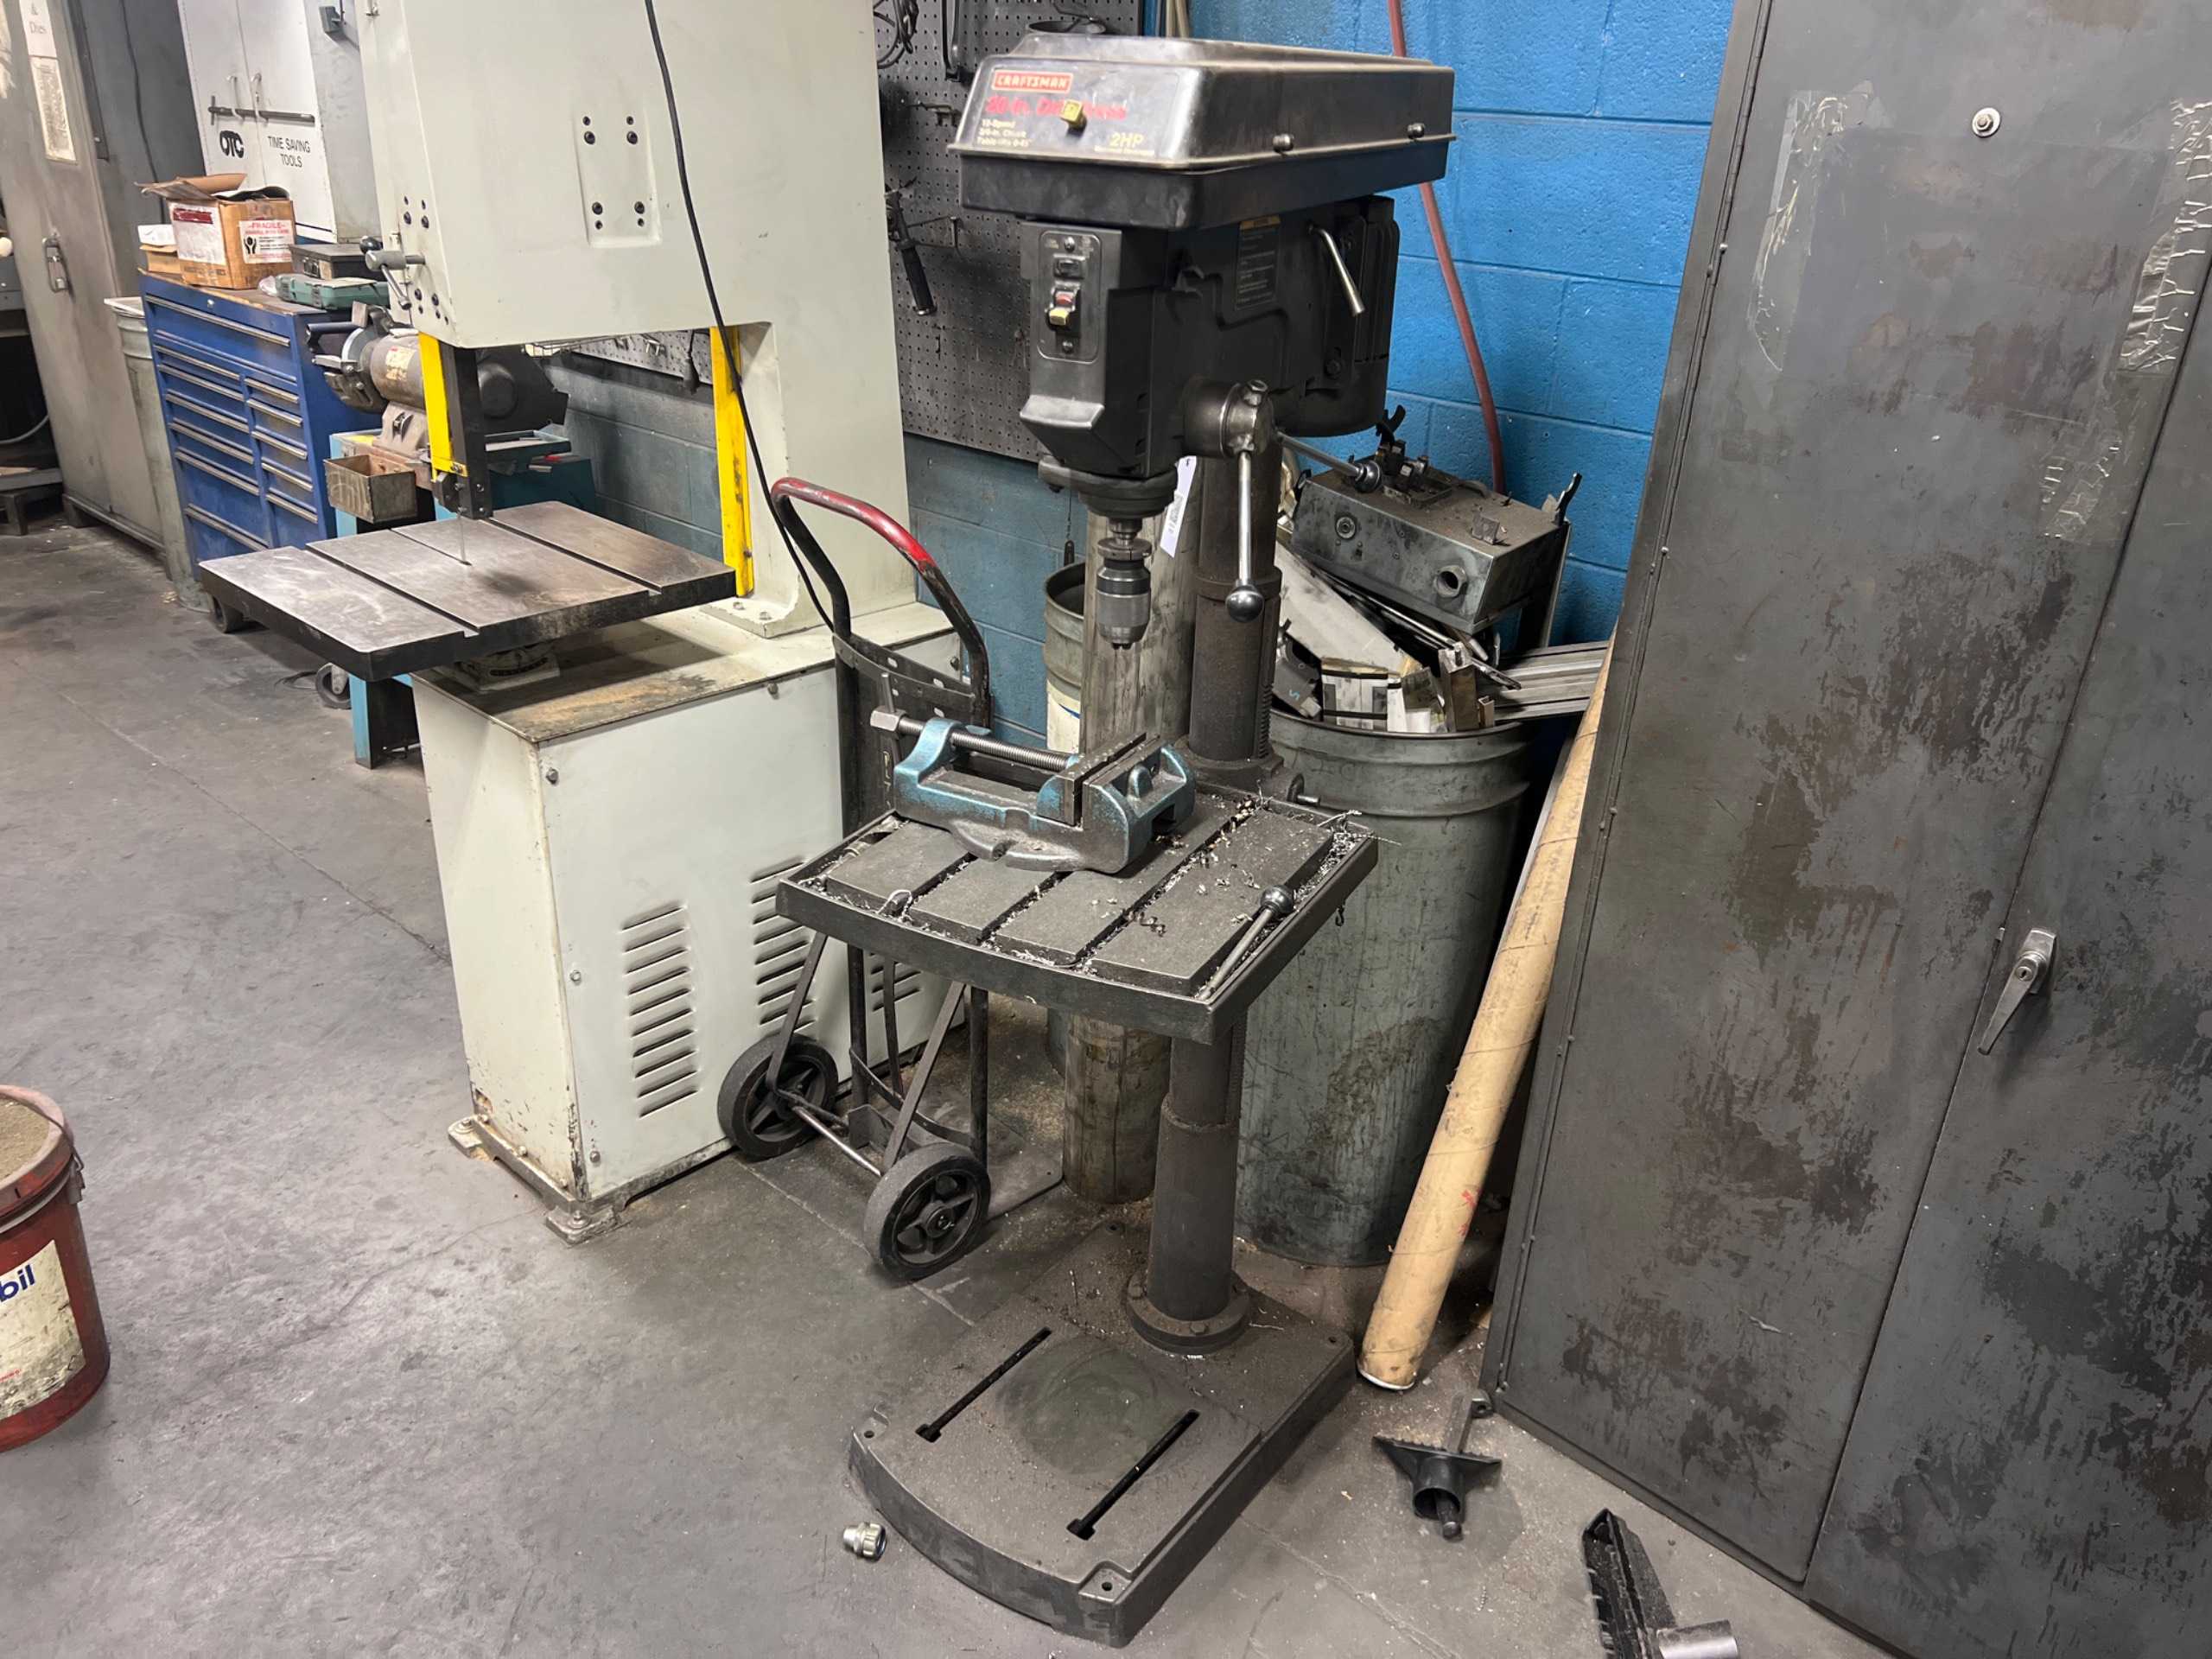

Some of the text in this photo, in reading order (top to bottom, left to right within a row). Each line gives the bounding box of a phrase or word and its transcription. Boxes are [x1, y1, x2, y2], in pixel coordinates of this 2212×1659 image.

[997, 74, 1067, 88] CRAFTSMAN
[219, 130, 245, 159] OTC
[267, 136, 311, 154] TIME SAVING
[1109, 131, 1145, 149] 2HP
[279, 153, 302, 168] TOOLS
